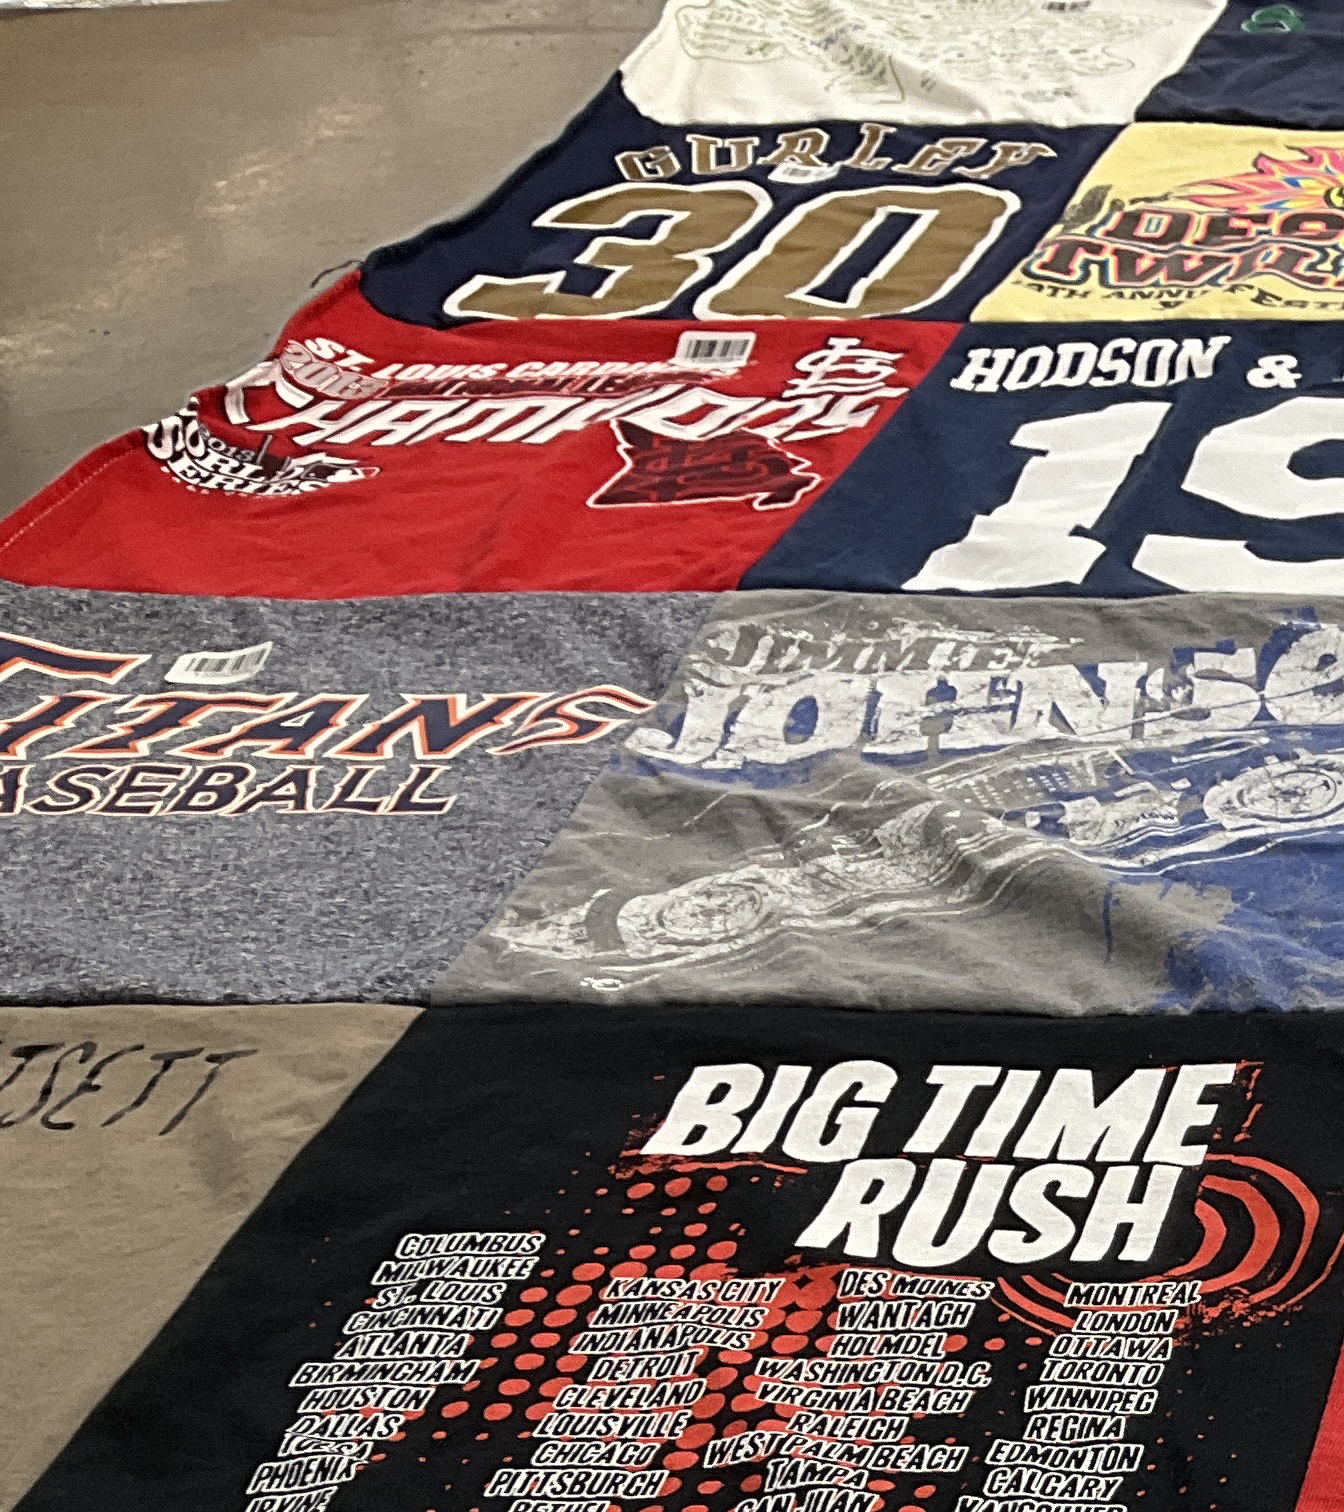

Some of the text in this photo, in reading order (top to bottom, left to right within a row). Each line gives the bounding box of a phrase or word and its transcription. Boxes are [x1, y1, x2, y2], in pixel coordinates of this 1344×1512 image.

[615, 121, 1056, 182] GURLEY
[443, 180, 1021, 321] 30
[304, 337, 372, 379] ST.
[373, 361, 508, 382] LOUIS
[949, 335, 1232, 393] HODSON
[1245, 354, 1302, 389] &
[639, 1059, 1239, 1167] BIG TIME
[795, 1158, 1182, 1267] RUSH
[396, 1232, 546, 1259] COLUMBUS
[371, 1256, 540, 1286] MILWAUKEE
[837, 1268, 996, 1300] DES MOINES
[420, 1280, 507, 1304] LOUIS
[604, 1277, 786, 1303] KANSAS CITY
[1064, 1281, 1202, 1307] MONTREAL
[342, 1305, 503, 1335] CINCINNATI
[589, 1301, 769, 1329] MINNEAPOLIS
[835, 1300, 976, 1330] WANTAGH
[1072, 1309, 1179, 1334] LONDON
[334, 1331, 470, 1361] ATLANTA
[569, 1324, 755, 1354] INDIANAPOLIS
[826, 1332, 948, 1360] HOLMDEL
[1049, 1334, 1173, 1360] OTTAWA
[288, 1358, 481, 1388] BIRMINGHAM
[587, 1349, 704, 1382] DETROIT
[755, 1356, 993, 1388] WASHINGTON D.C.
[1040, 1358, 1165, 1387] TORONTO
[297, 1386, 436, 1413] HOUSTON
[552, 1379, 707, 1410] CLEVELAND
[756, 1382, 973, 1414] VIRGINIA BEACH
[1024, 1385, 1158, 1415] WINNIPEG
[286, 1413, 405, 1440] DALLAS
[532, 1410, 692, 1439] LOUISVILLE
[786, 1411, 909, 1441] RALEIGH
[1022, 1413, 1126, 1442] REGINA
[531, 1441, 661, 1467] CHICAGO
[703, 1430, 970, 1473] WEST PALM BEACH
[985, 1439, 1145, 1474] EDMONTON
[246, 1454, 366, 1495] PHOENIX
[484, 1469, 669, 1498] PITTSBURGH
[764, 1457, 869, 1493] TAMPA
[983, 1467, 1124, 1500] CALGARY
